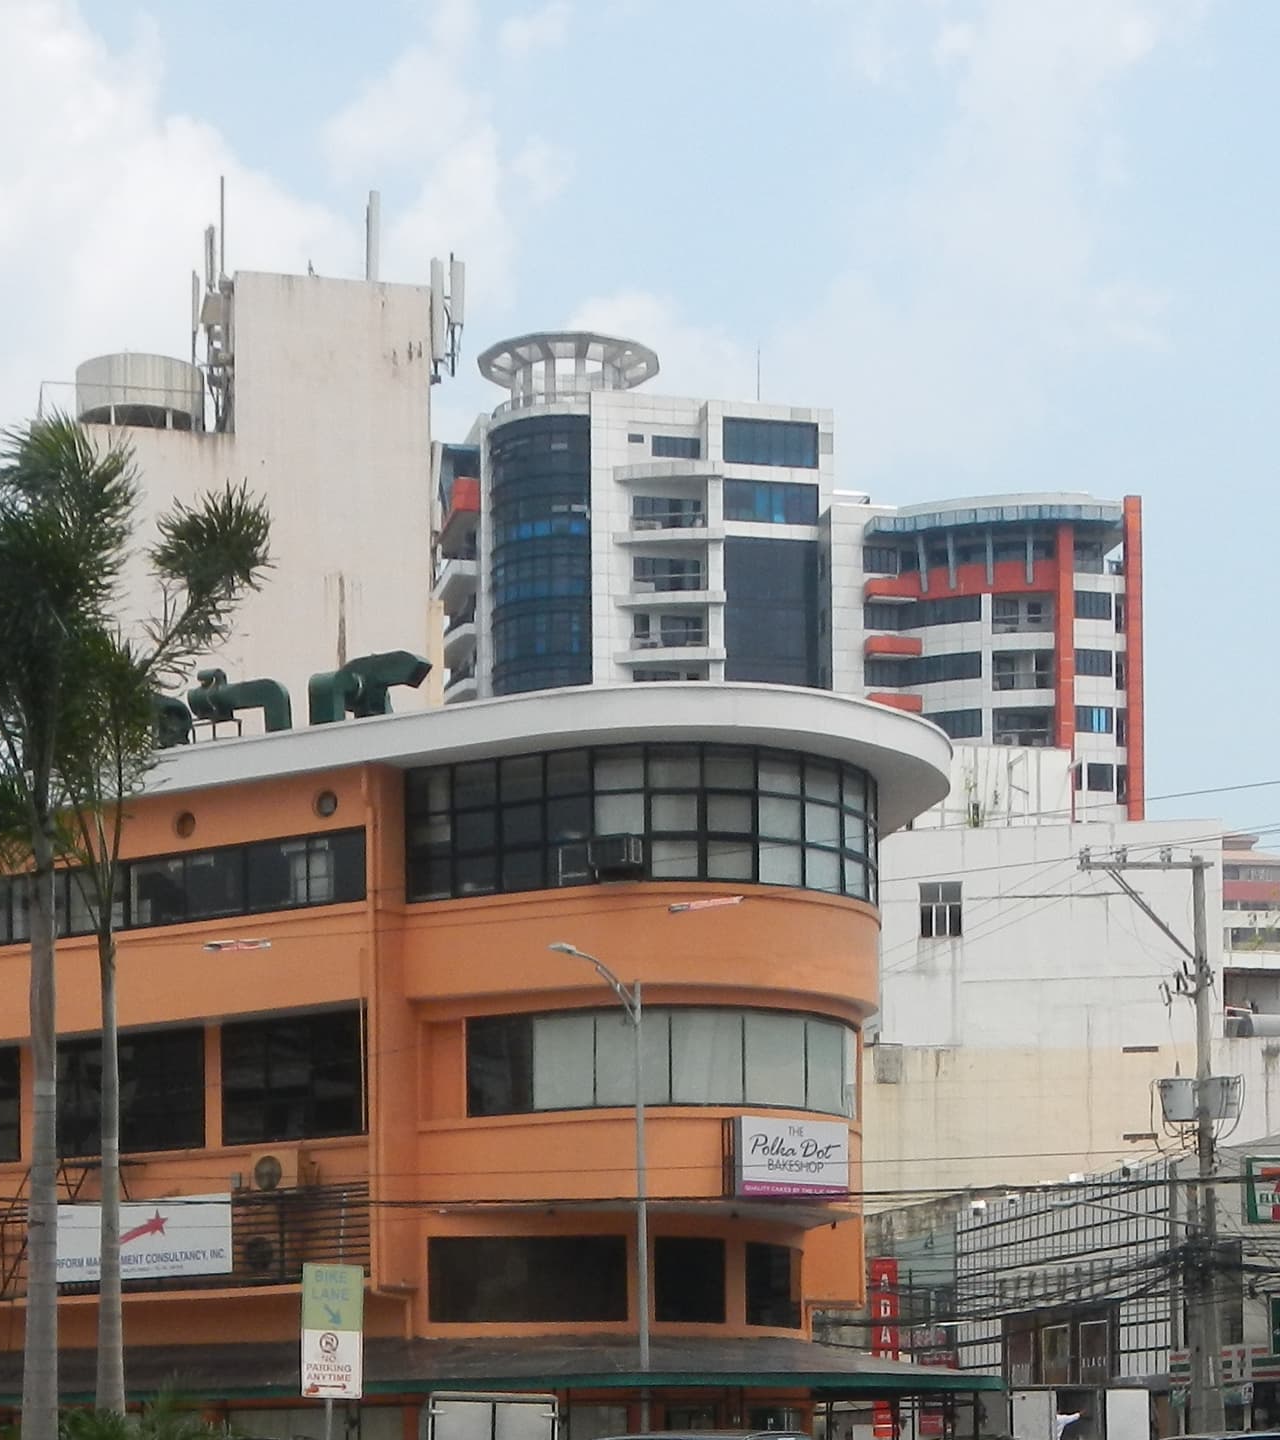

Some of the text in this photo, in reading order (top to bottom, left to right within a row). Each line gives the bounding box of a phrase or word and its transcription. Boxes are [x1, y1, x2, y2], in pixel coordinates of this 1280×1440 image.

[788, 1125, 804, 1137] THE
[748, 1133, 841, 1160] Polka Dot
[767, 1158, 825, 1173] BAKESHOP
[56, 1248, 227, 1269] RFORM MAMENT CONSULTANCY, INC.
[314, 1269, 349, 1284] BIKE
[311, 1286, 351, 1301] LANE
[320, 1354, 337, 1363] NO
[305, 1363, 352, 1374] PARKING
[305, 1372, 352, 1383] ANYTIME
